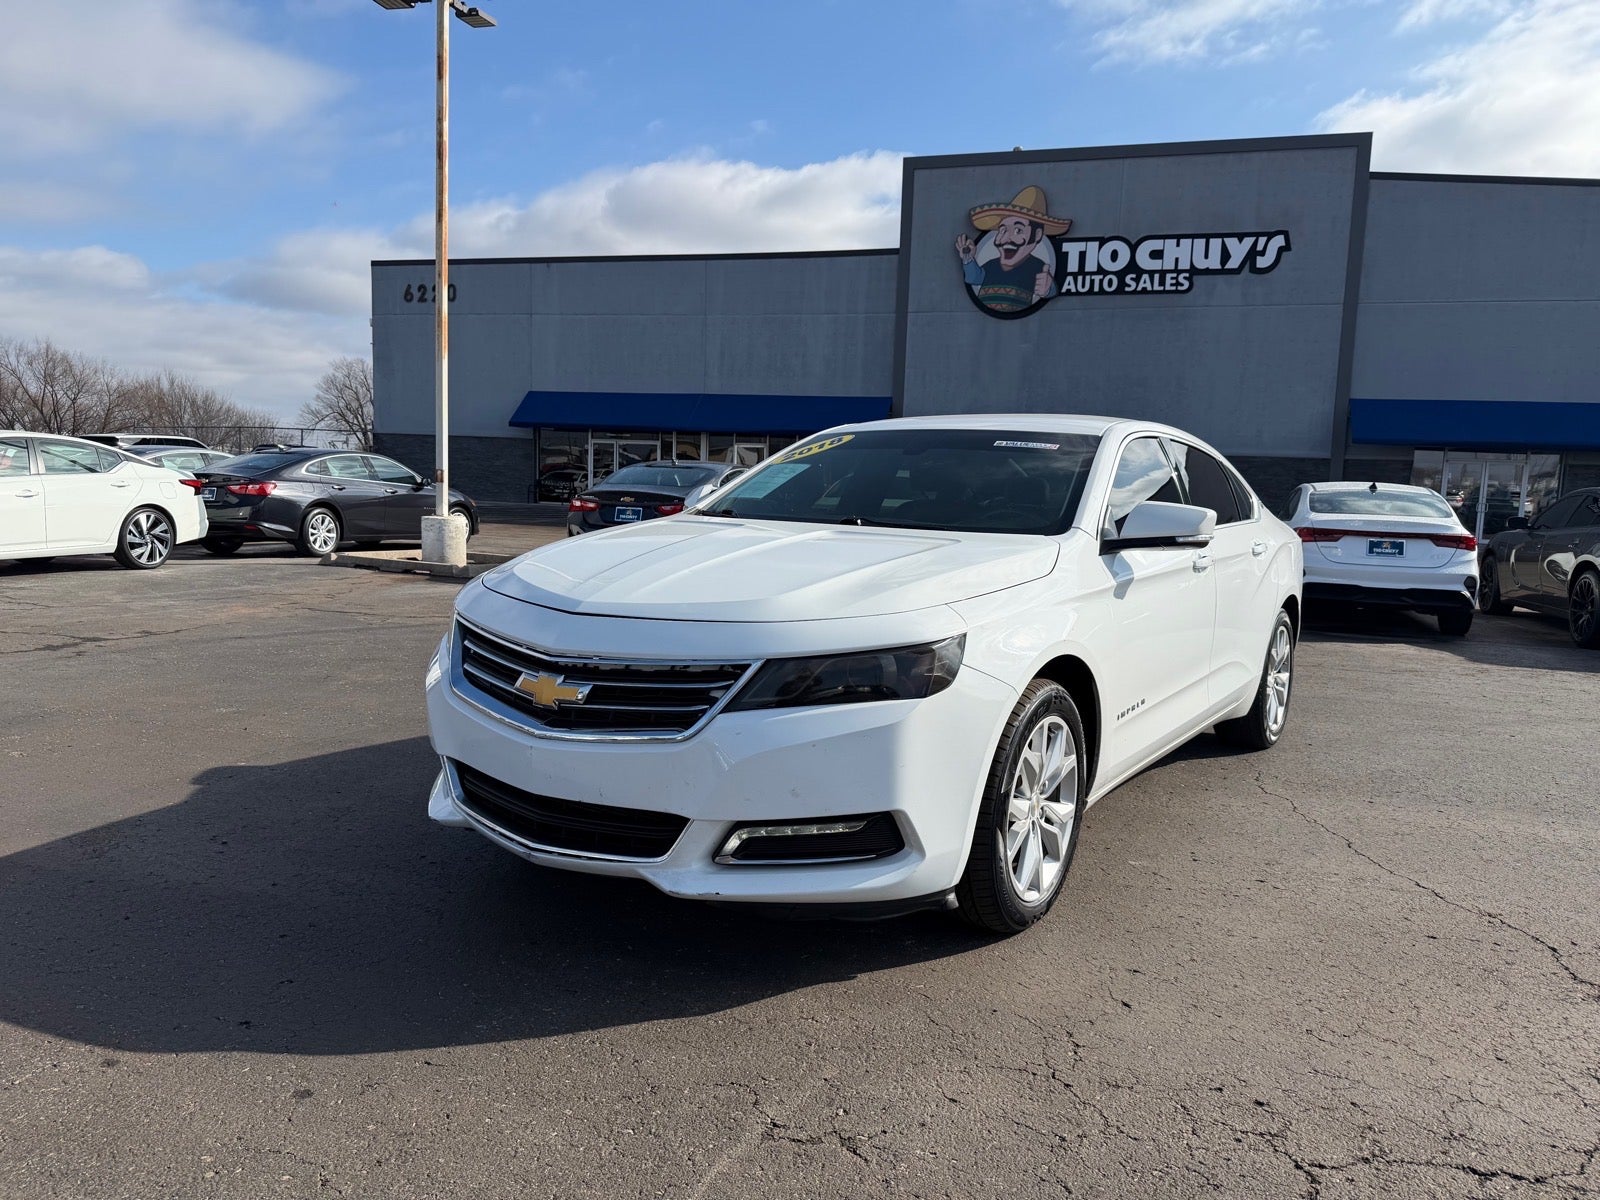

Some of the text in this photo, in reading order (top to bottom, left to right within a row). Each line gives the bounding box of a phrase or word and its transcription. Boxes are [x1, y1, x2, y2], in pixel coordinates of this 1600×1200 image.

[1061, 234, 1286, 273] TIO CHUY'S
[1061, 273, 1190, 293] AUTO SALES
[782, 437, 844, 460] 2018
